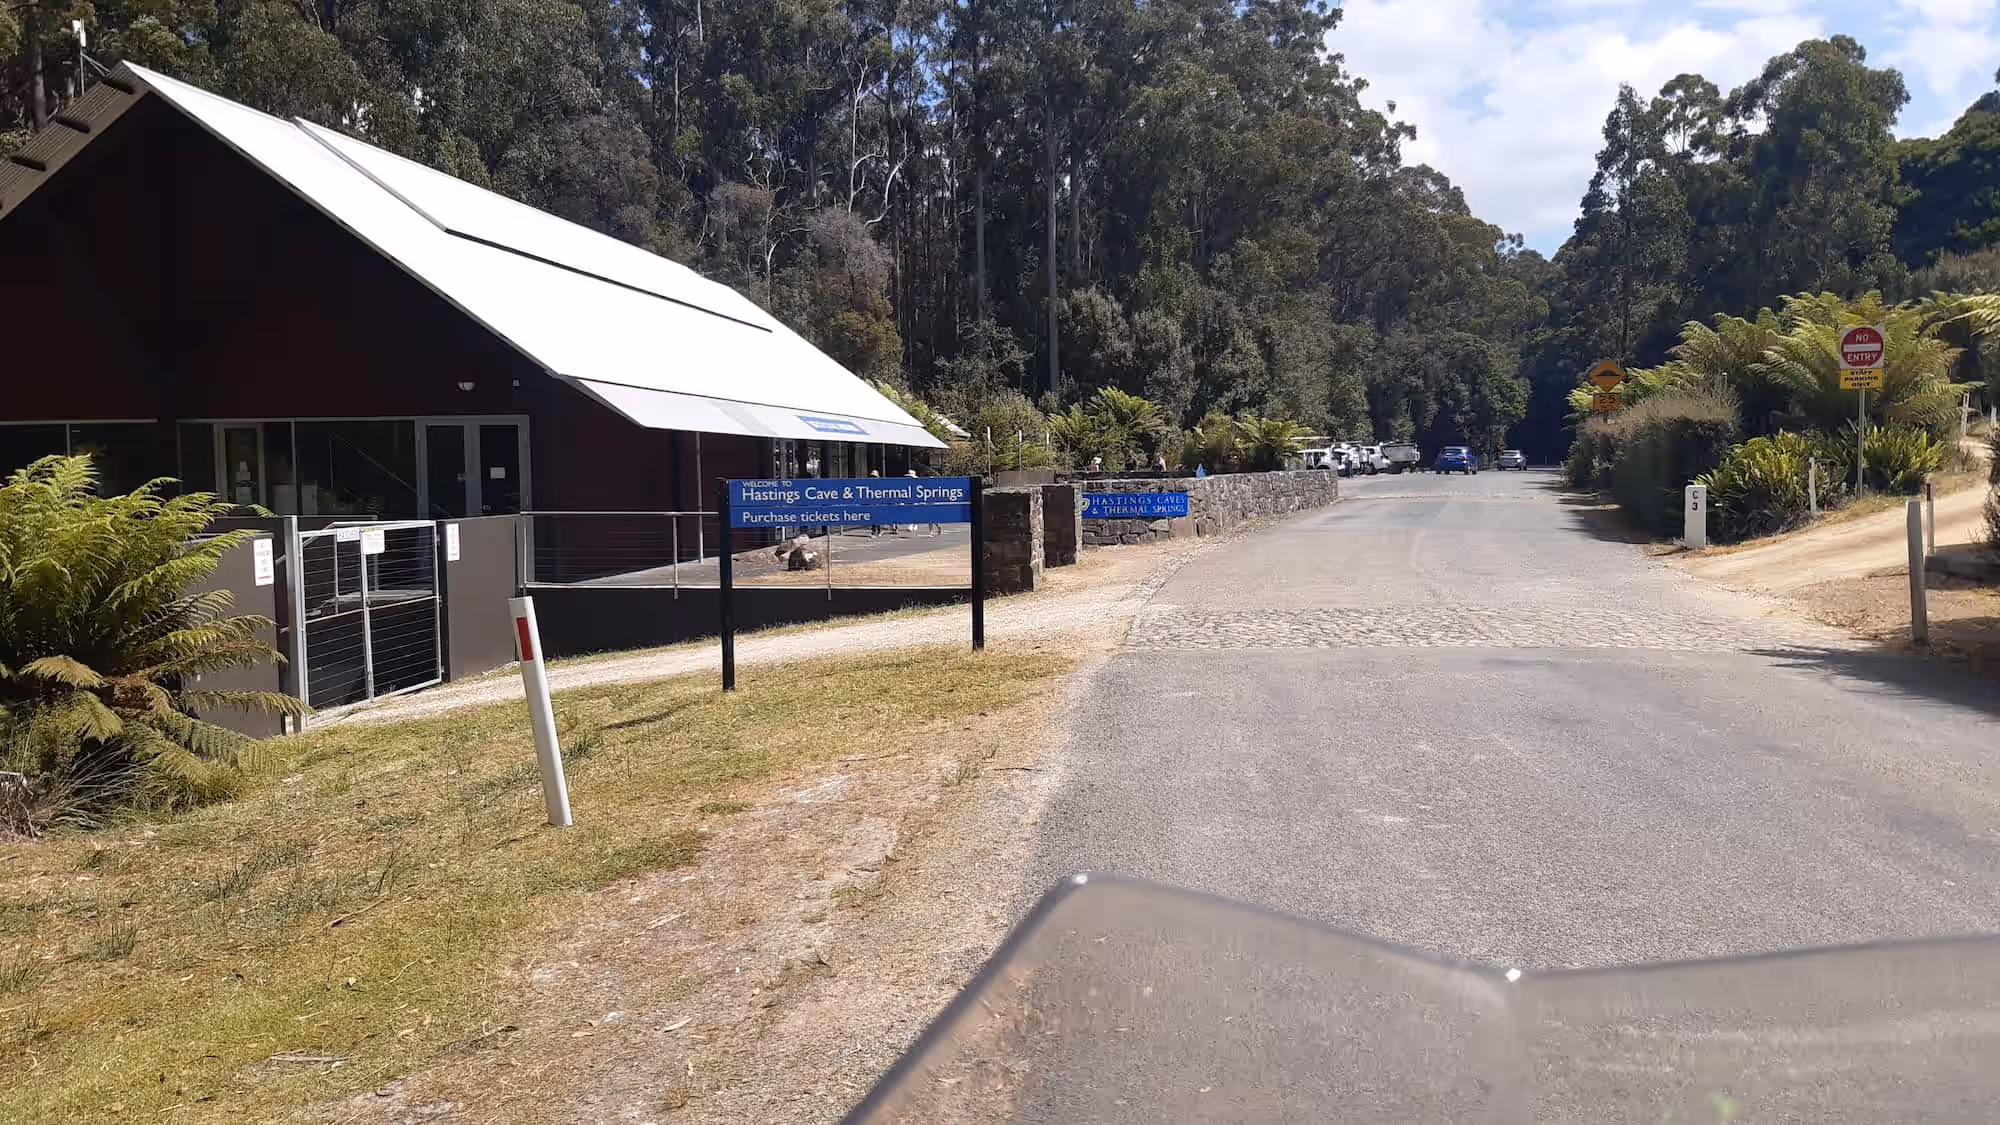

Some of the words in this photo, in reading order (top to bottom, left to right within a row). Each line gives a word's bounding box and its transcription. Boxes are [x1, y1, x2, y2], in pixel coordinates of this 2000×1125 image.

[1855, 334, 1869, 343] NO
[1847, 352, 1878, 362] ENTRY
[742, 480, 779, 488] WELCOME
[742, 487, 801, 504] Hastings
[804, 486, 839, 500] Cave
[842, 486, 854, 499] &
[855, 485, 912, 499] Thermal
[916, 485, 964, 501] Springs
[1092, 495, 1152, 505] HASTINGS
[1156, 495, 1185, 504] CAVES
[1103, 506, 1149, 515] THERMAL
[1152, 505, 1185, 513] SPRINGS
[1691, 502, 1699, 511] 3
[742, 511, 797, 523] Purchase
[800, 510, 840, 522] tickets
[843, 509, 871, 521] here
